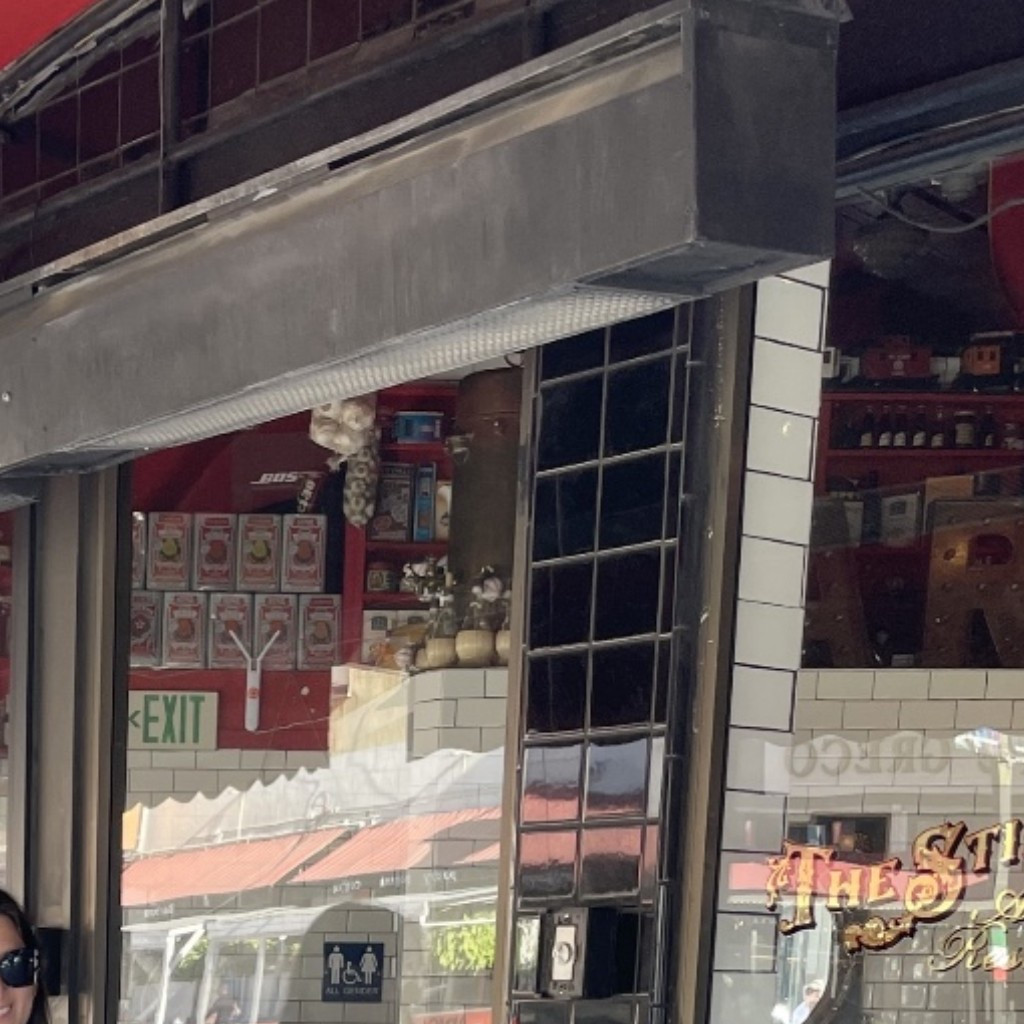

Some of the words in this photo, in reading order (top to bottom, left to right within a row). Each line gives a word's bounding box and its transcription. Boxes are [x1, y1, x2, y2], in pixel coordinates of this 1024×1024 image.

[142, 694, 205, 743] EXIT
[902, 818, 1024, 924] STI
[325, 986, 339, 995] ALL
